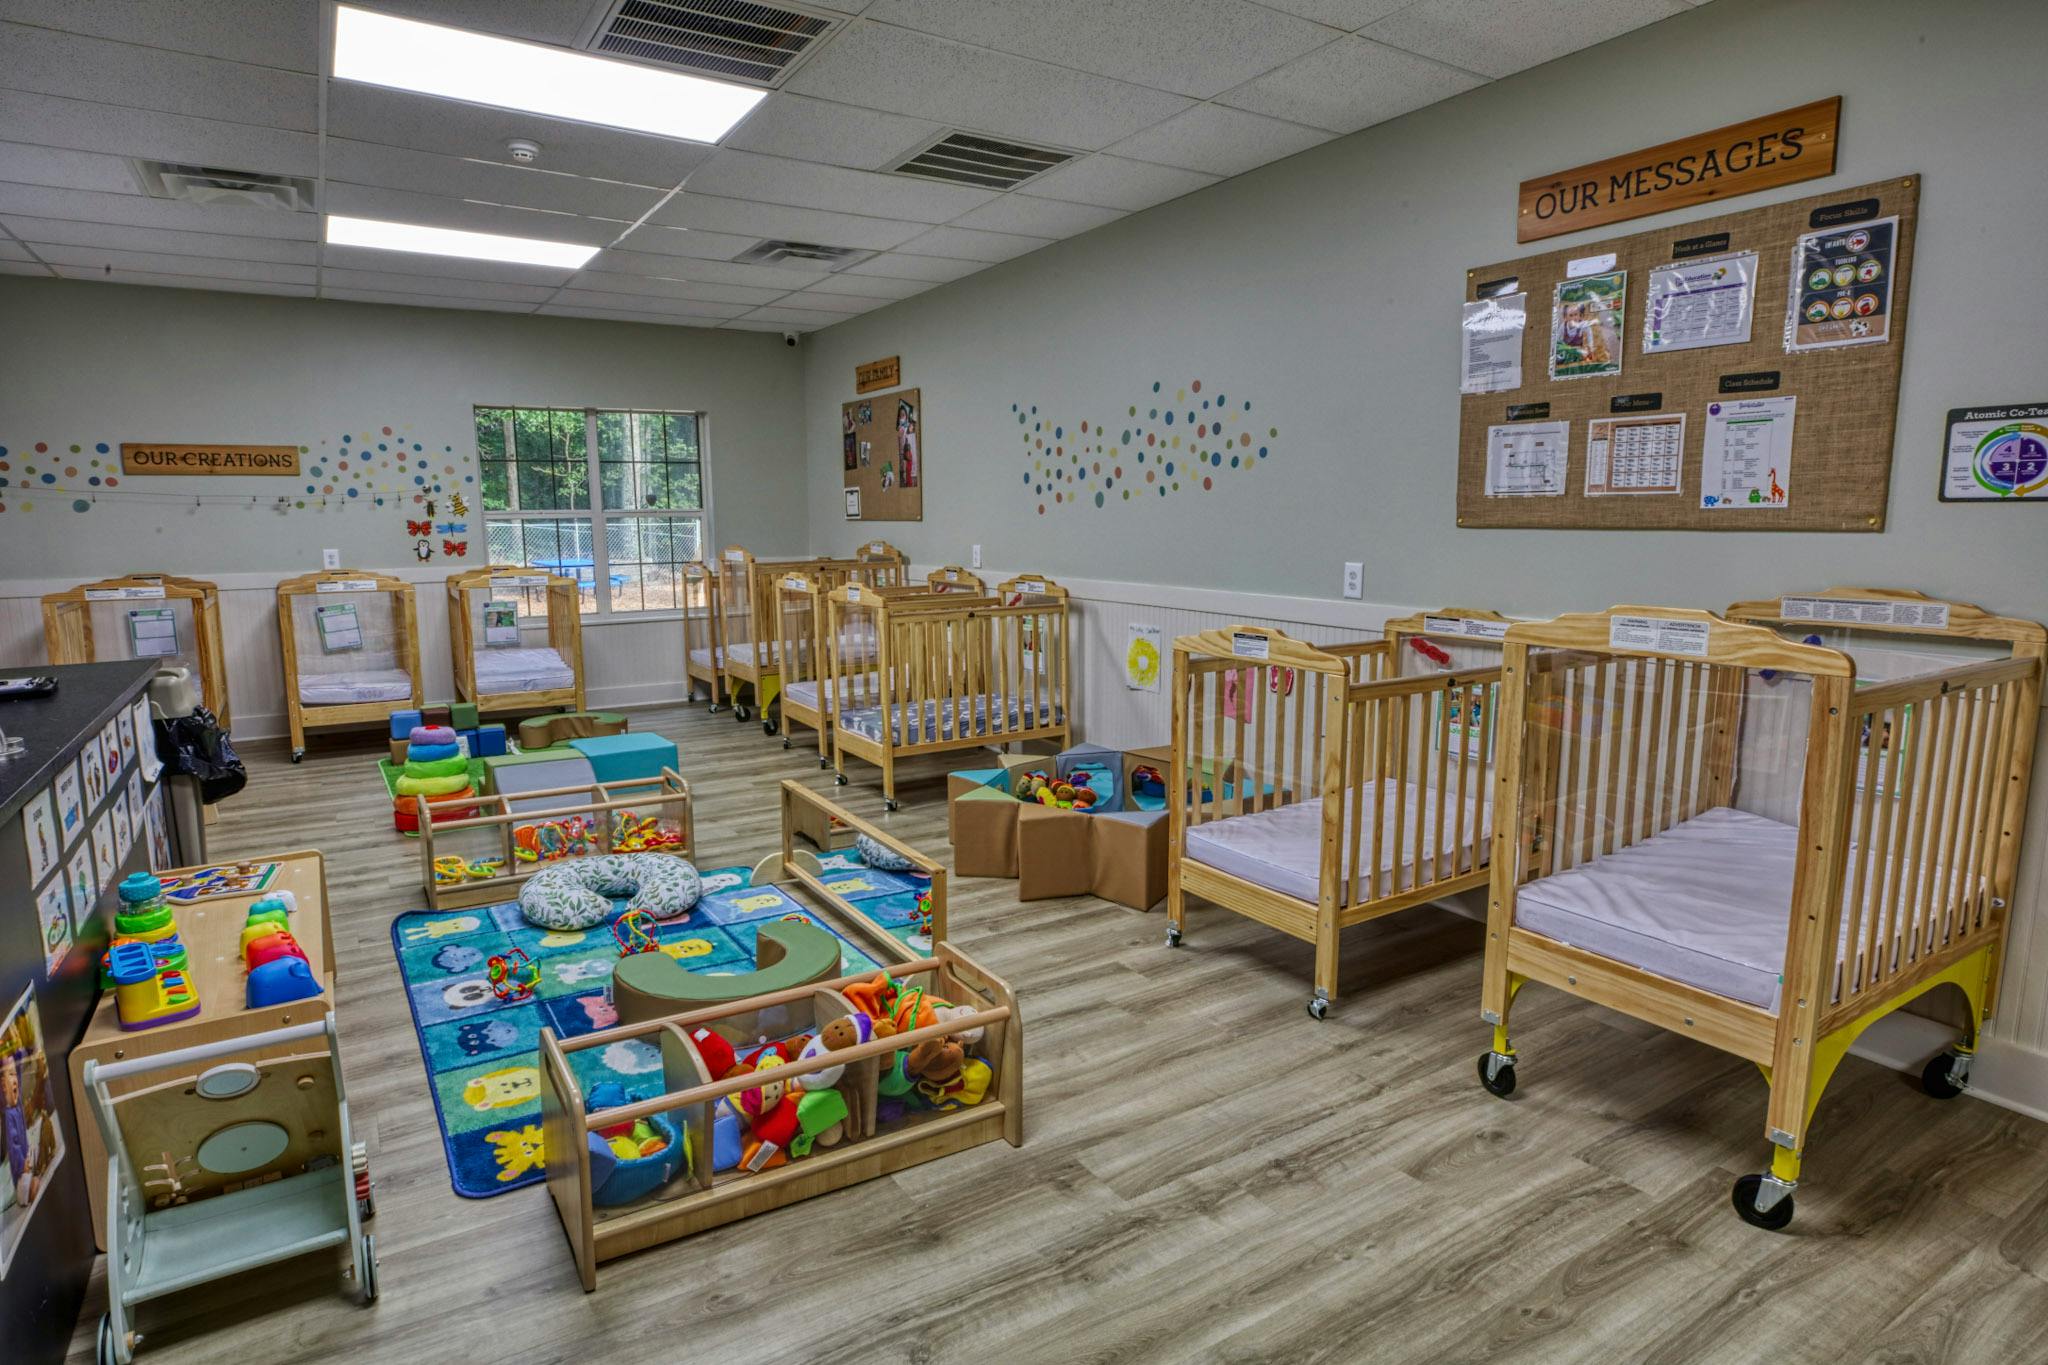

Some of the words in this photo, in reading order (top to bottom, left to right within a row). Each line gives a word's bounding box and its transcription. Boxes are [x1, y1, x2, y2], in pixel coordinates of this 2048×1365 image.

[1535, 181, 1599, 220] OUR
[1608, 127, 1805, 203] MESSAGES
[1819, 211, 1843, 222] Focus
[1844, 206, 1868, 217] Skills
[1964, 410, 2007, 421] Atomic
[2004, 445, 2012, 453] 4
[2029, 444, 2036, 452] 1
[133, 450, 178, 466] OUR
[182, 452, 293, 468] CREATIONS
[2002, 462, 2010, 471] 3
[2027, 462, 2035, 470] 2
